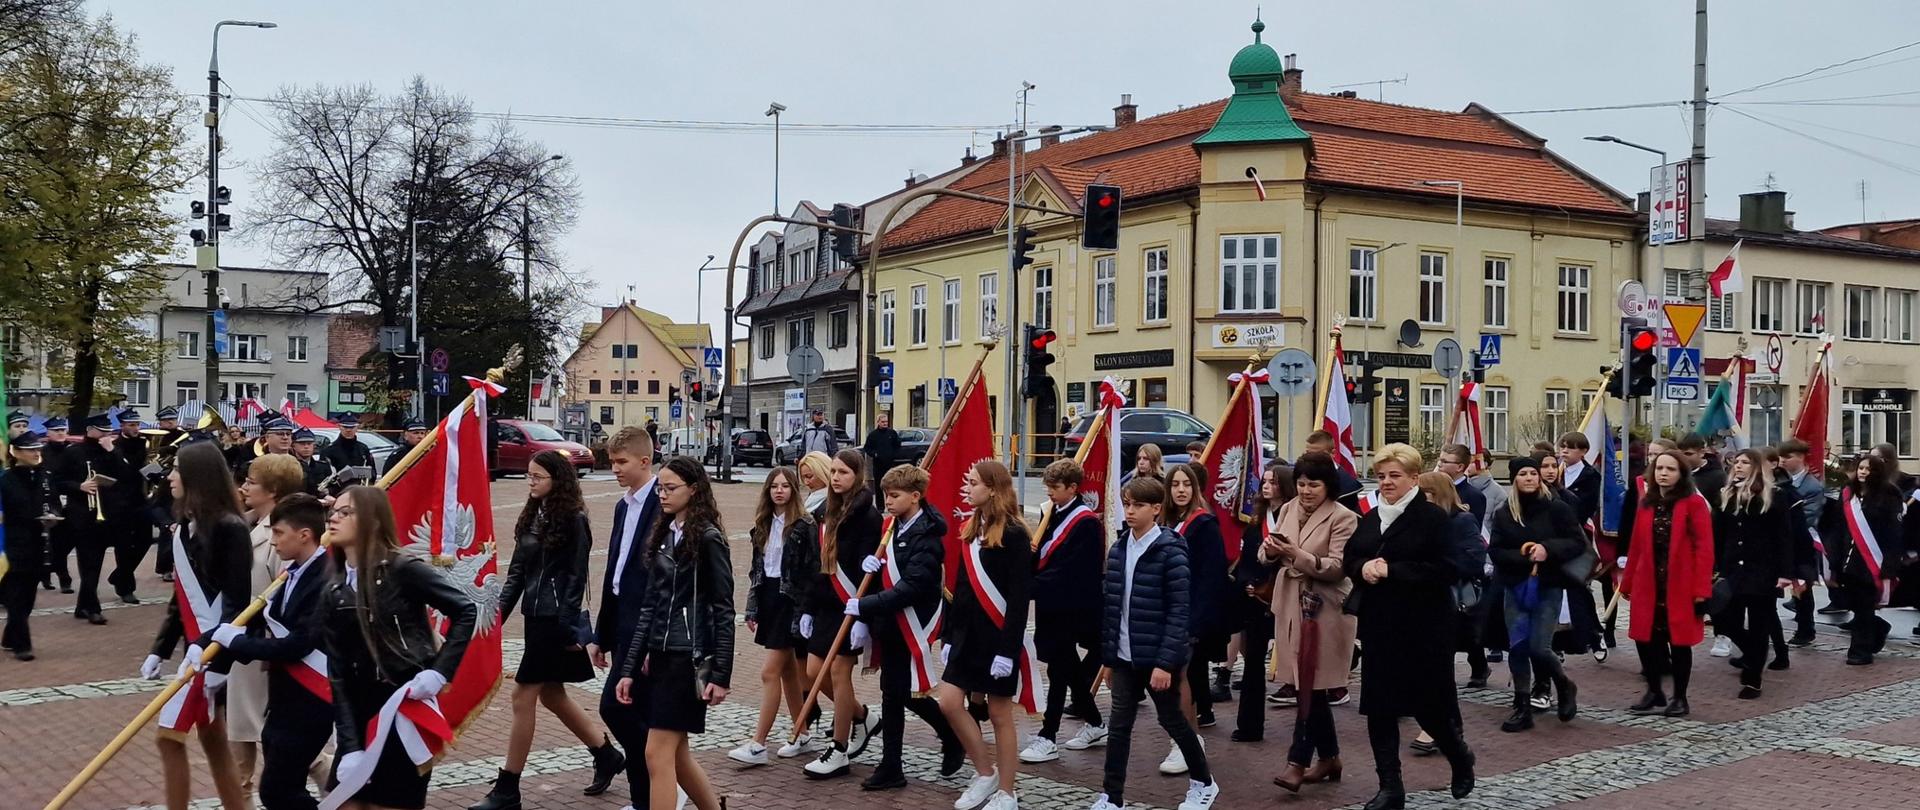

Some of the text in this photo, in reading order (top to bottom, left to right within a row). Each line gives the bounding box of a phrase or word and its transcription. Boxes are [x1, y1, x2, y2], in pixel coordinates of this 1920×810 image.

[1677, 165, 1687, 238] HOTEL
[1246, 325, 1275, 337] SZKOŁA
[1095, 356, 1117, 367] SALON
[1671, 387, 1687, 396] PKS
[1863, 403, 1904, 411] ALKOHOLE
